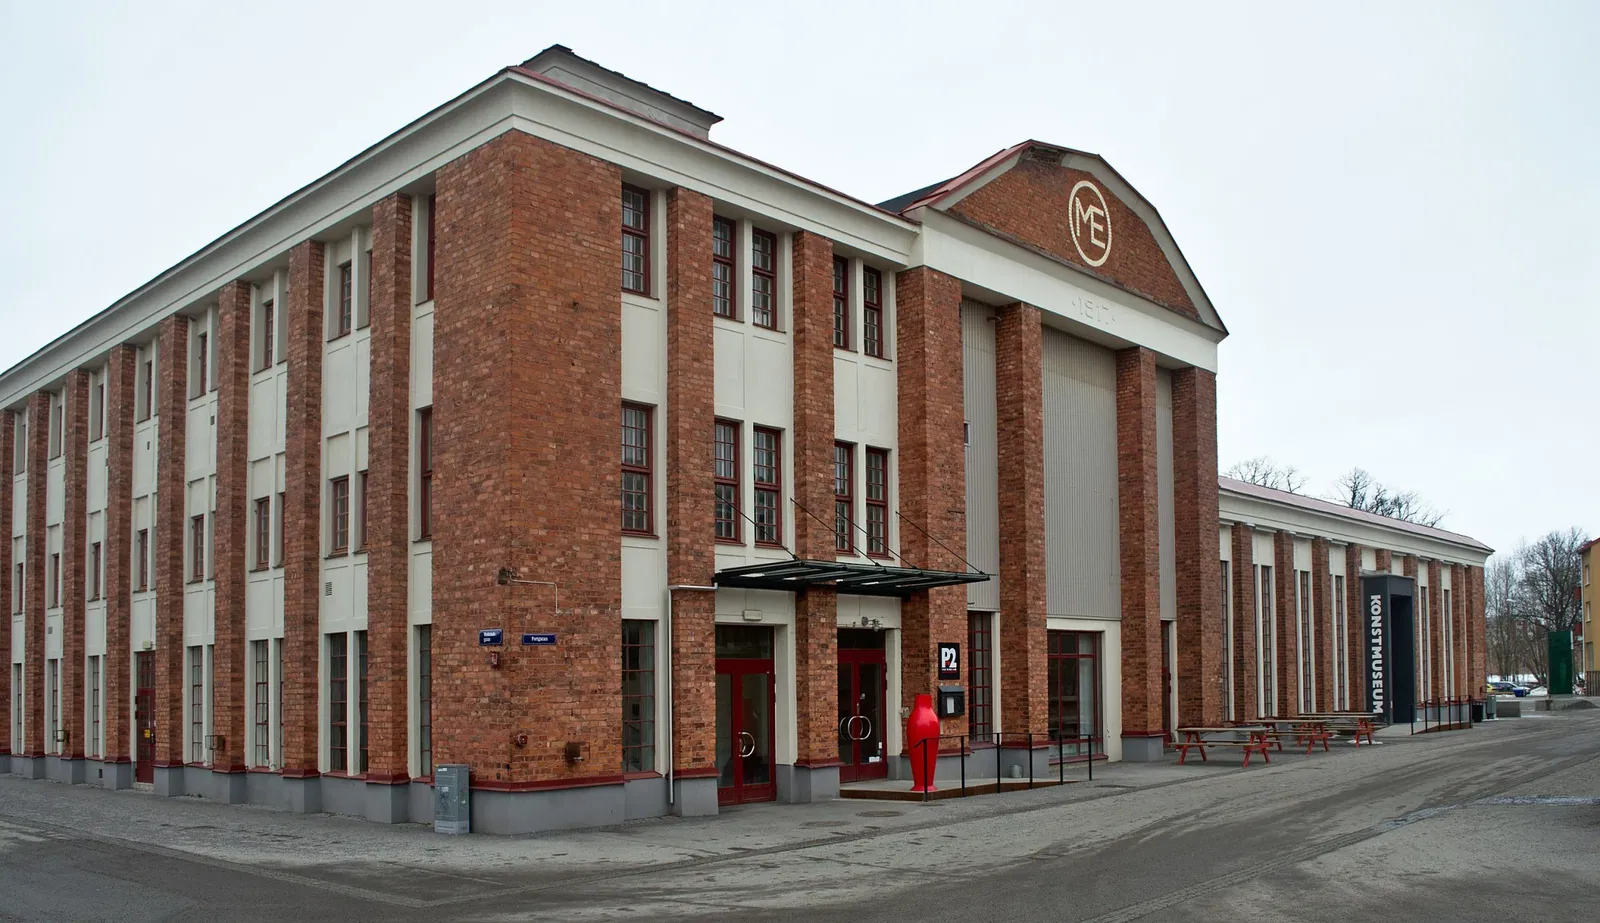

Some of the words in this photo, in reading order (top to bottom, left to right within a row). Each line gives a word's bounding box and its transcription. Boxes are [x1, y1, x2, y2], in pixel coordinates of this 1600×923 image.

[1075, 196, 1105, 249] ME
[941, 647, 957, 668] P2
[1370, 594, 1384, 714] KONSTMUSEUM
